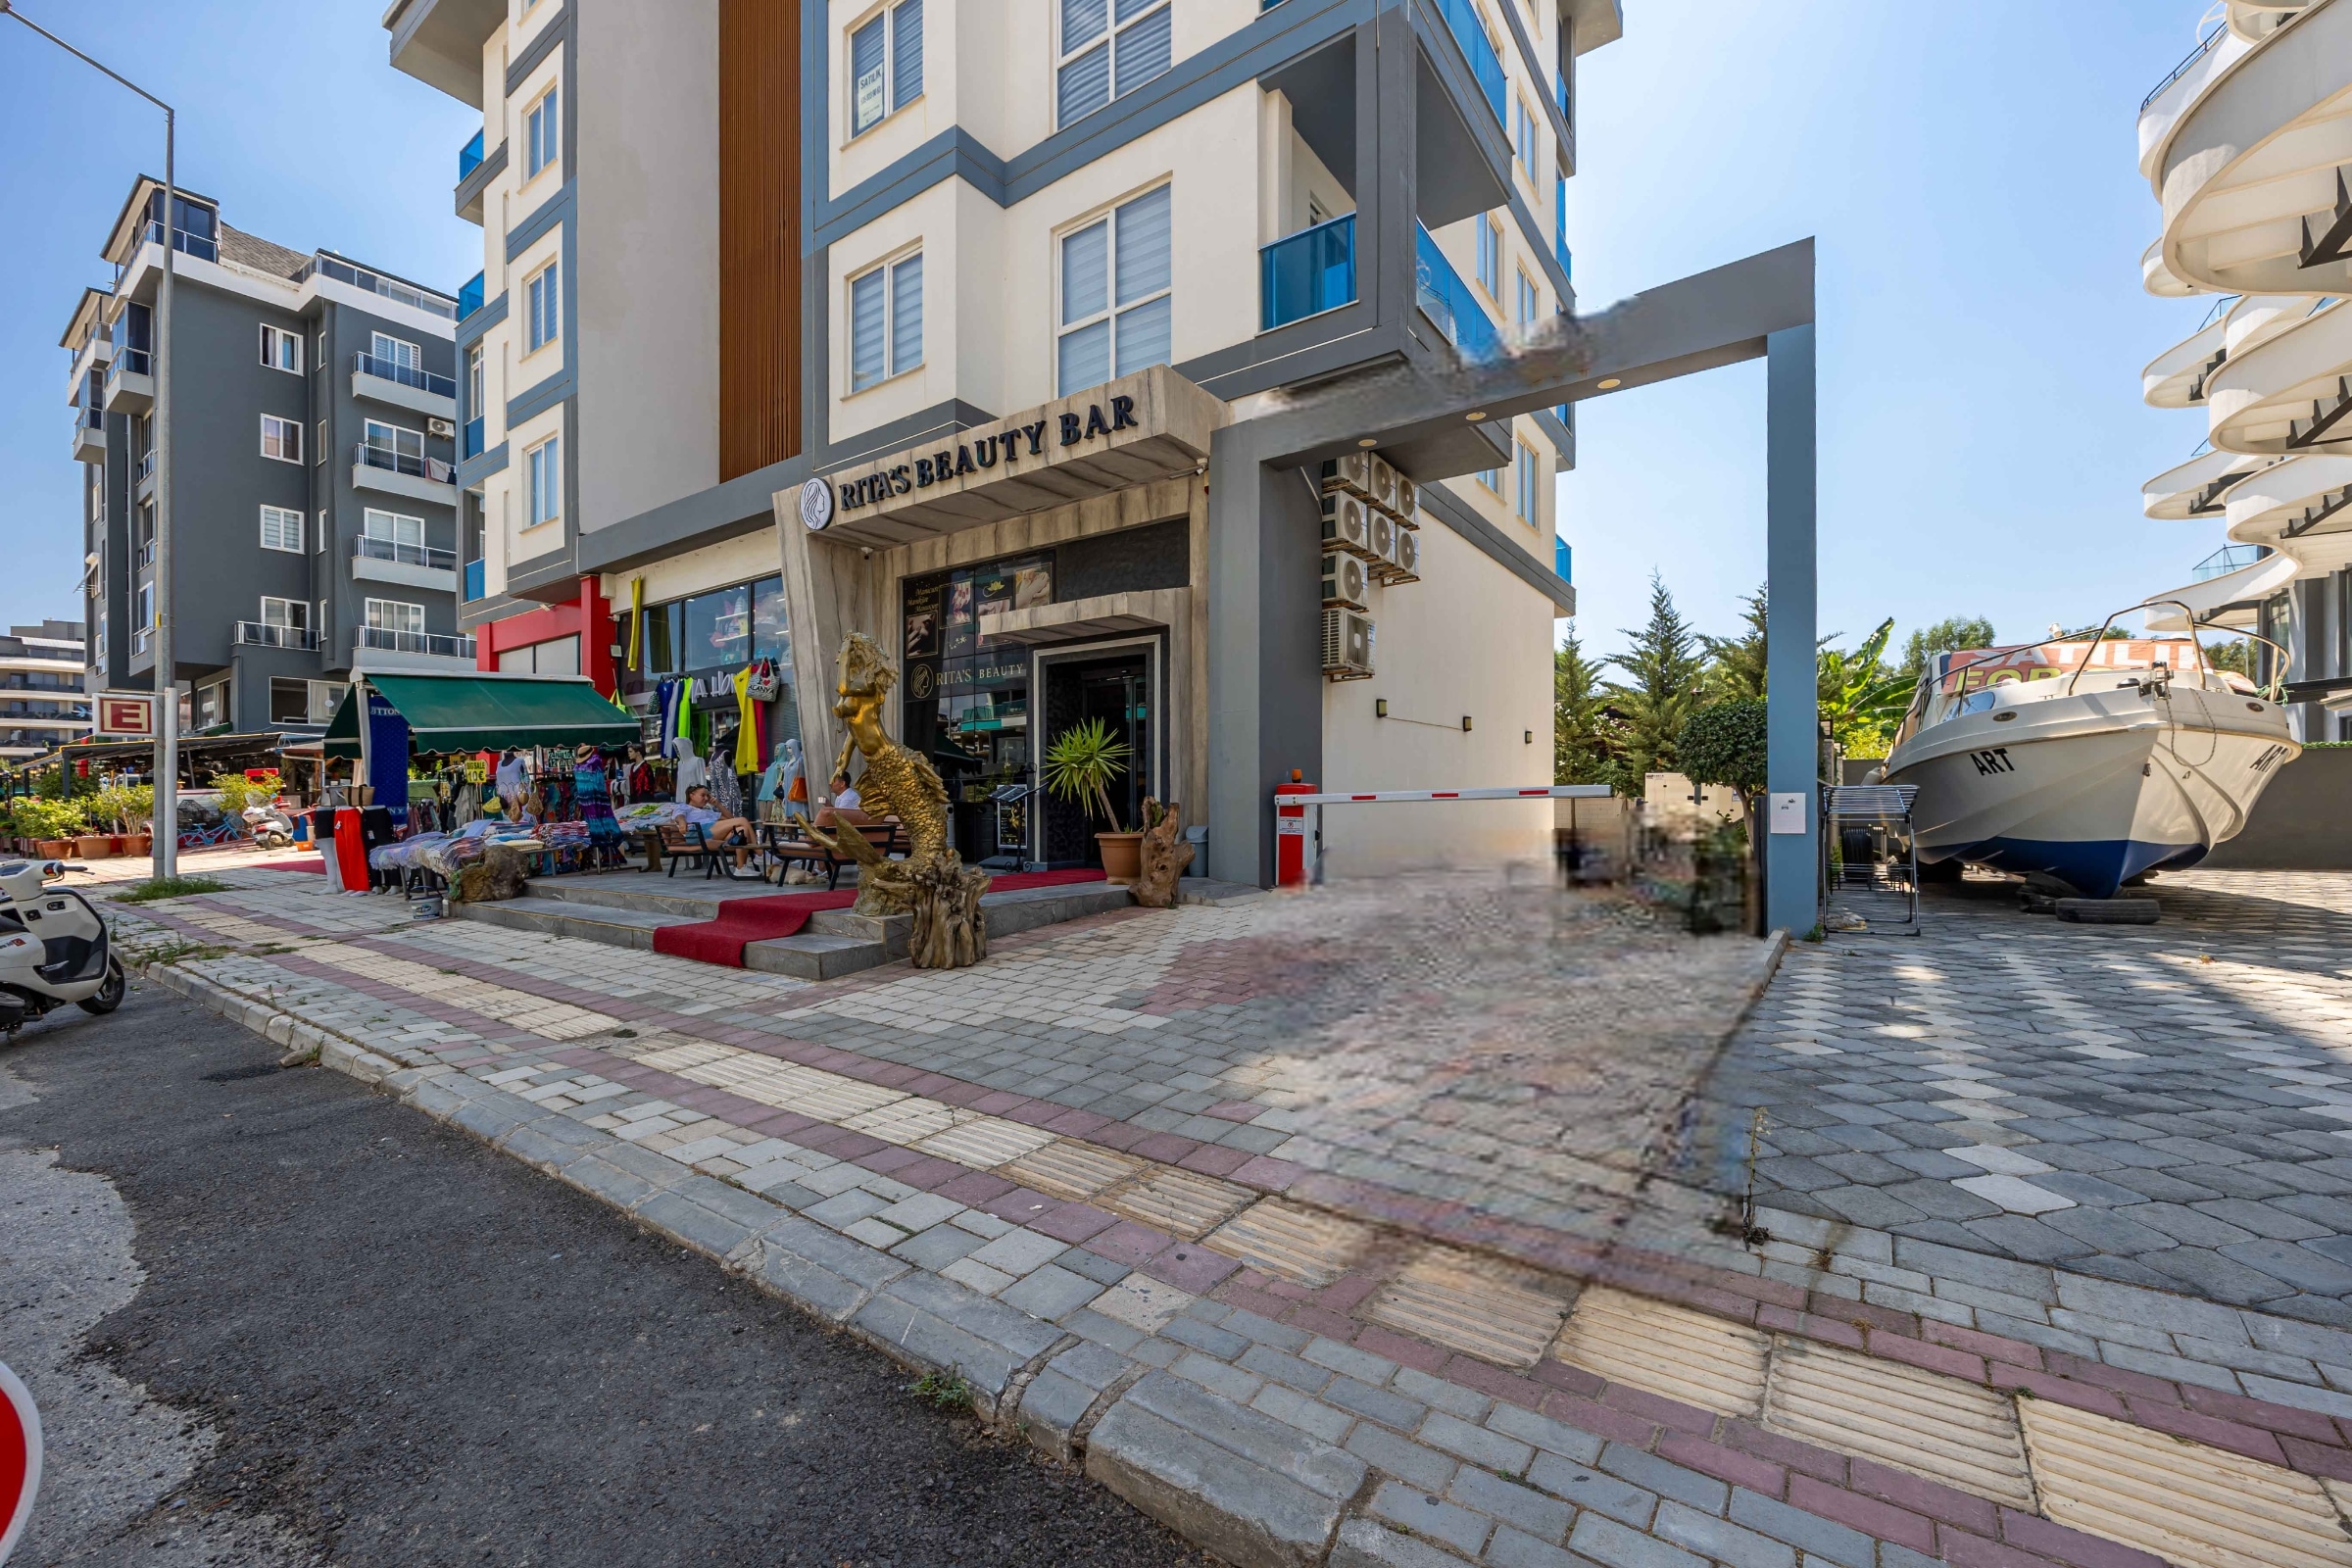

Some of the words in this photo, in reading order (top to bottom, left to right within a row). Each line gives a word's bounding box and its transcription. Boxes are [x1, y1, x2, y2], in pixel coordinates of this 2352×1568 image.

[859, 68, 882, 90] SATILIK
[839, 465, 911, 511] RITA'S
[914, 419, 1047, 488] BEAUTY
[1058, 395, 1139, 446] BAR
[936, 668, 972, 686] RITA'S
[979, 663, 1024, 679] BEAUTY
[111, 703, 142, 729] E
[1969, 748, 2015, 776] ART
[2249, 744, 2288, 772] ART
